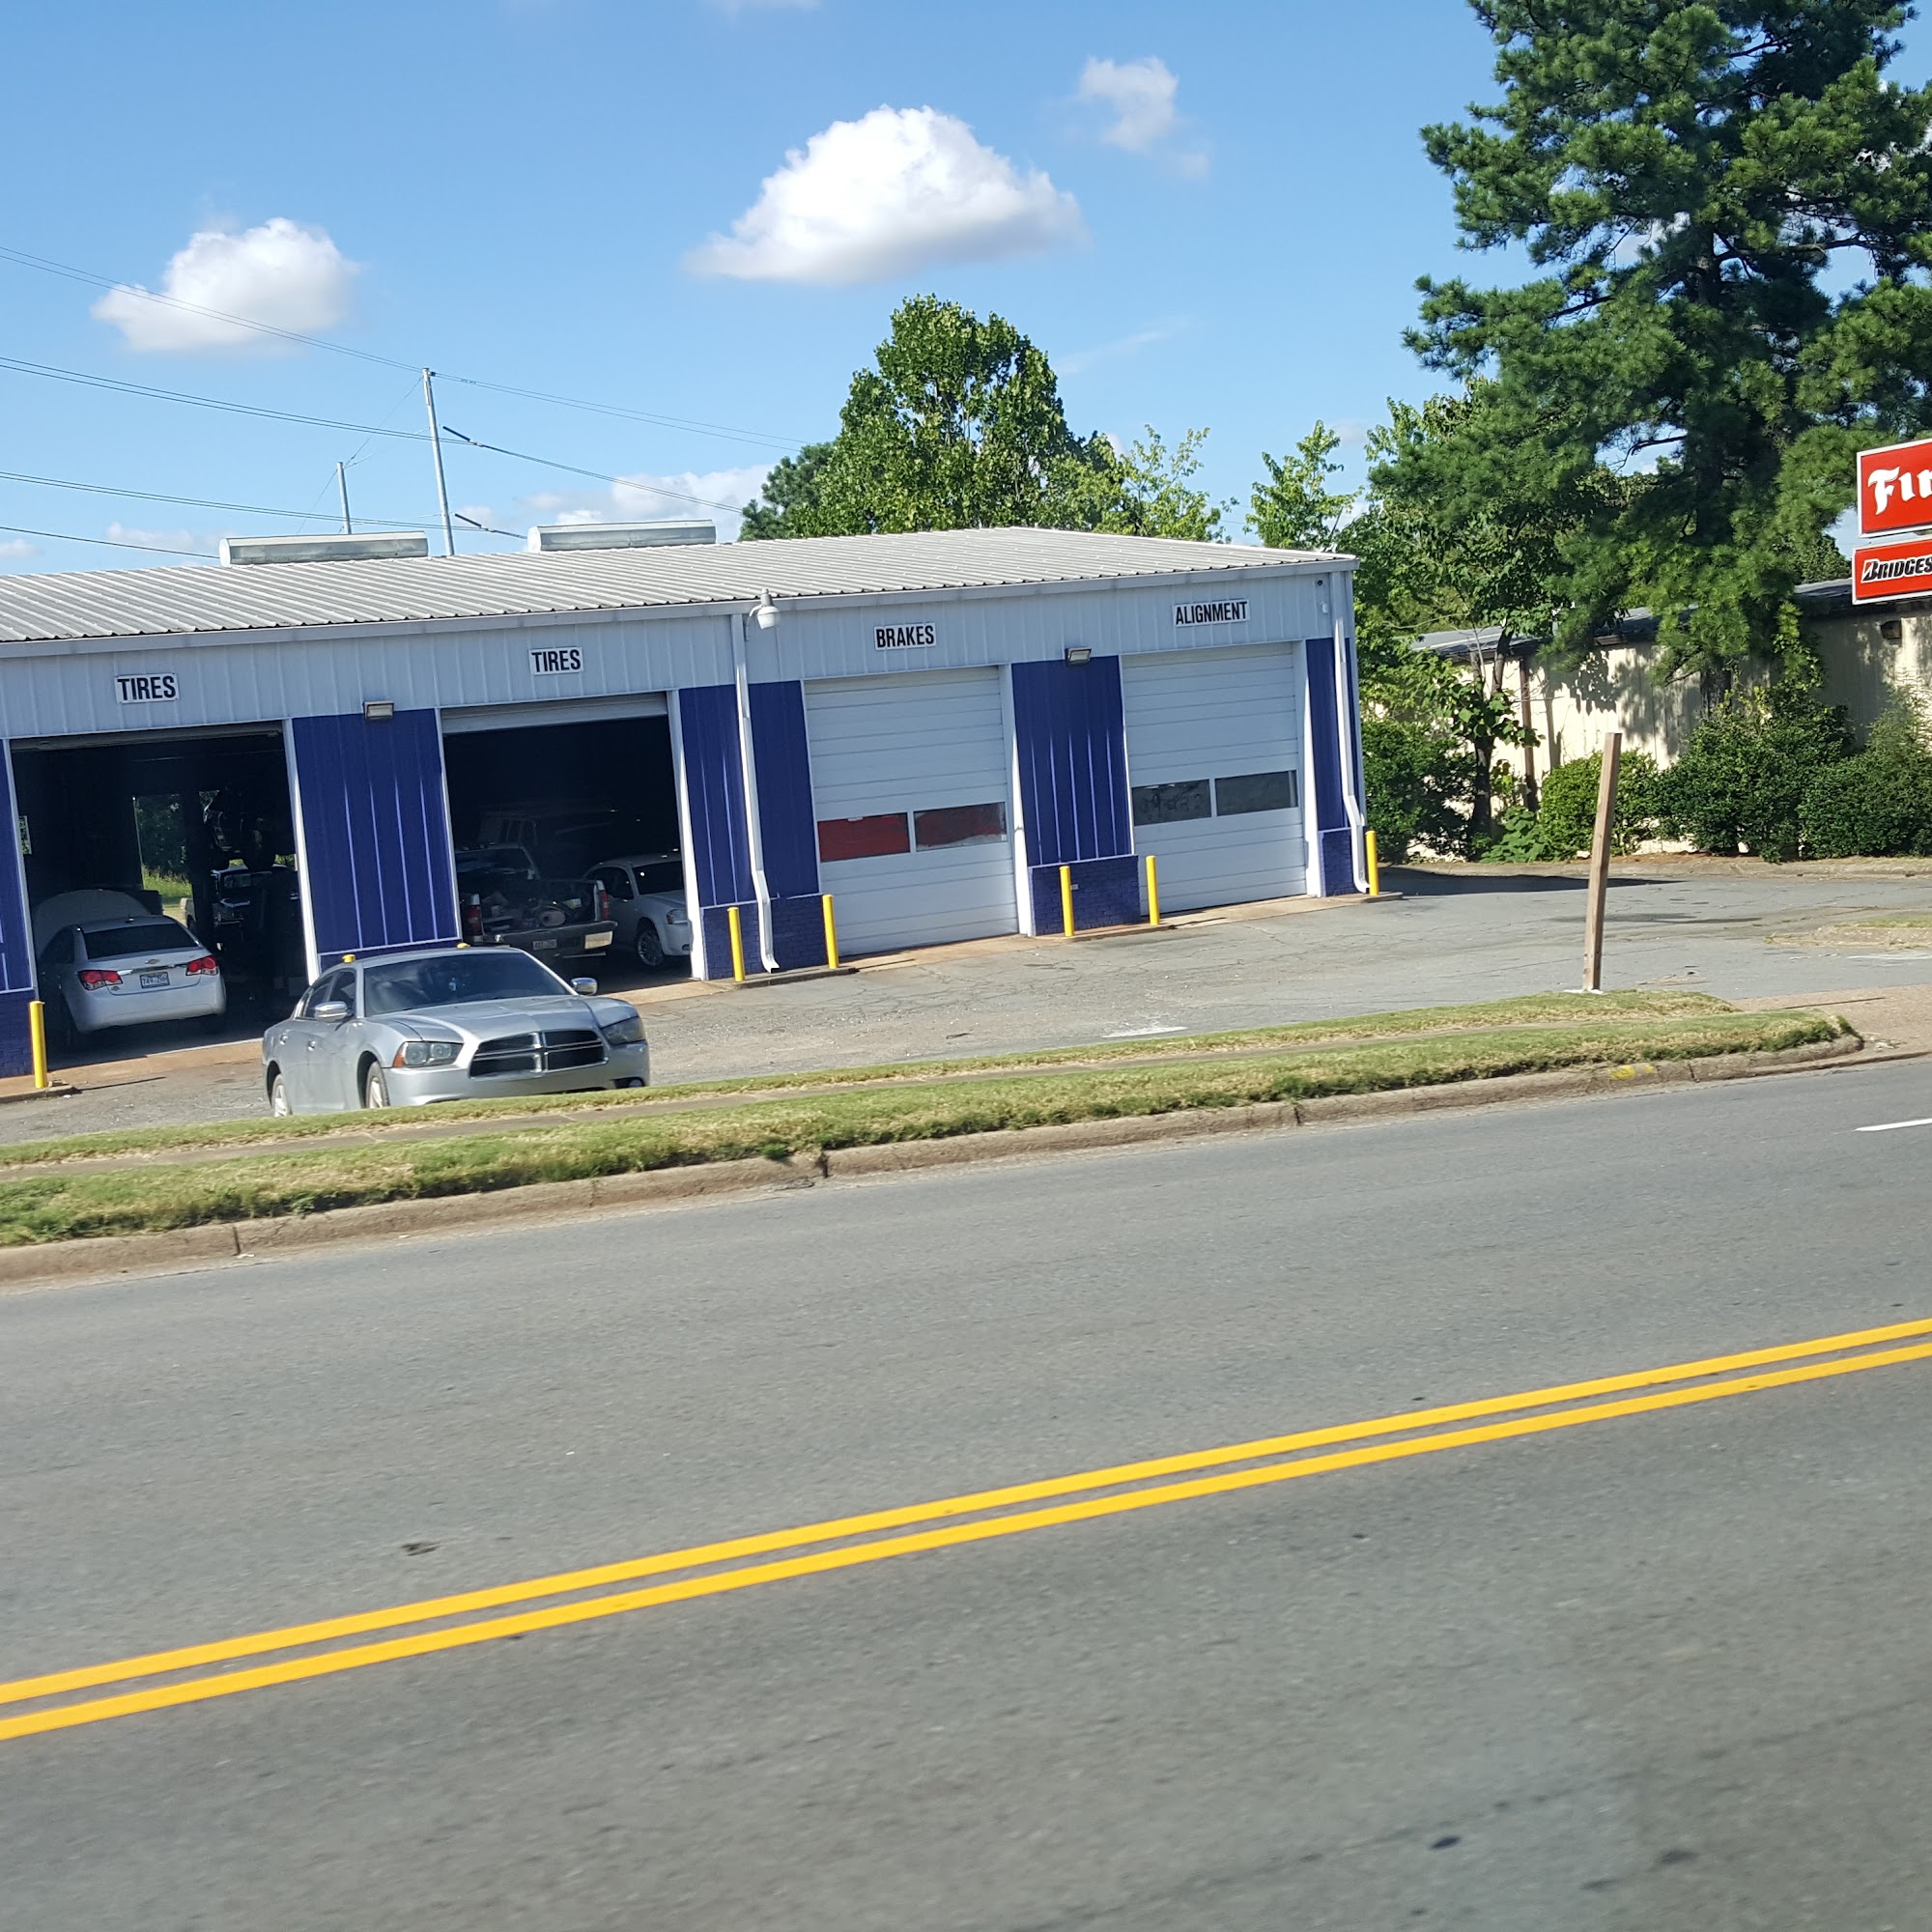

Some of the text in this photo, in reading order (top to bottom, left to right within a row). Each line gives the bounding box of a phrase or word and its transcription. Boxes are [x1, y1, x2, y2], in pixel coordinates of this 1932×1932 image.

[1176, 601, 1247, 625] ALIGNMENT
[876, 625, 935, 648] BRAKES
[531, 649, 582, 672] TIRES
[117, 675, 176, 700] TIRES
